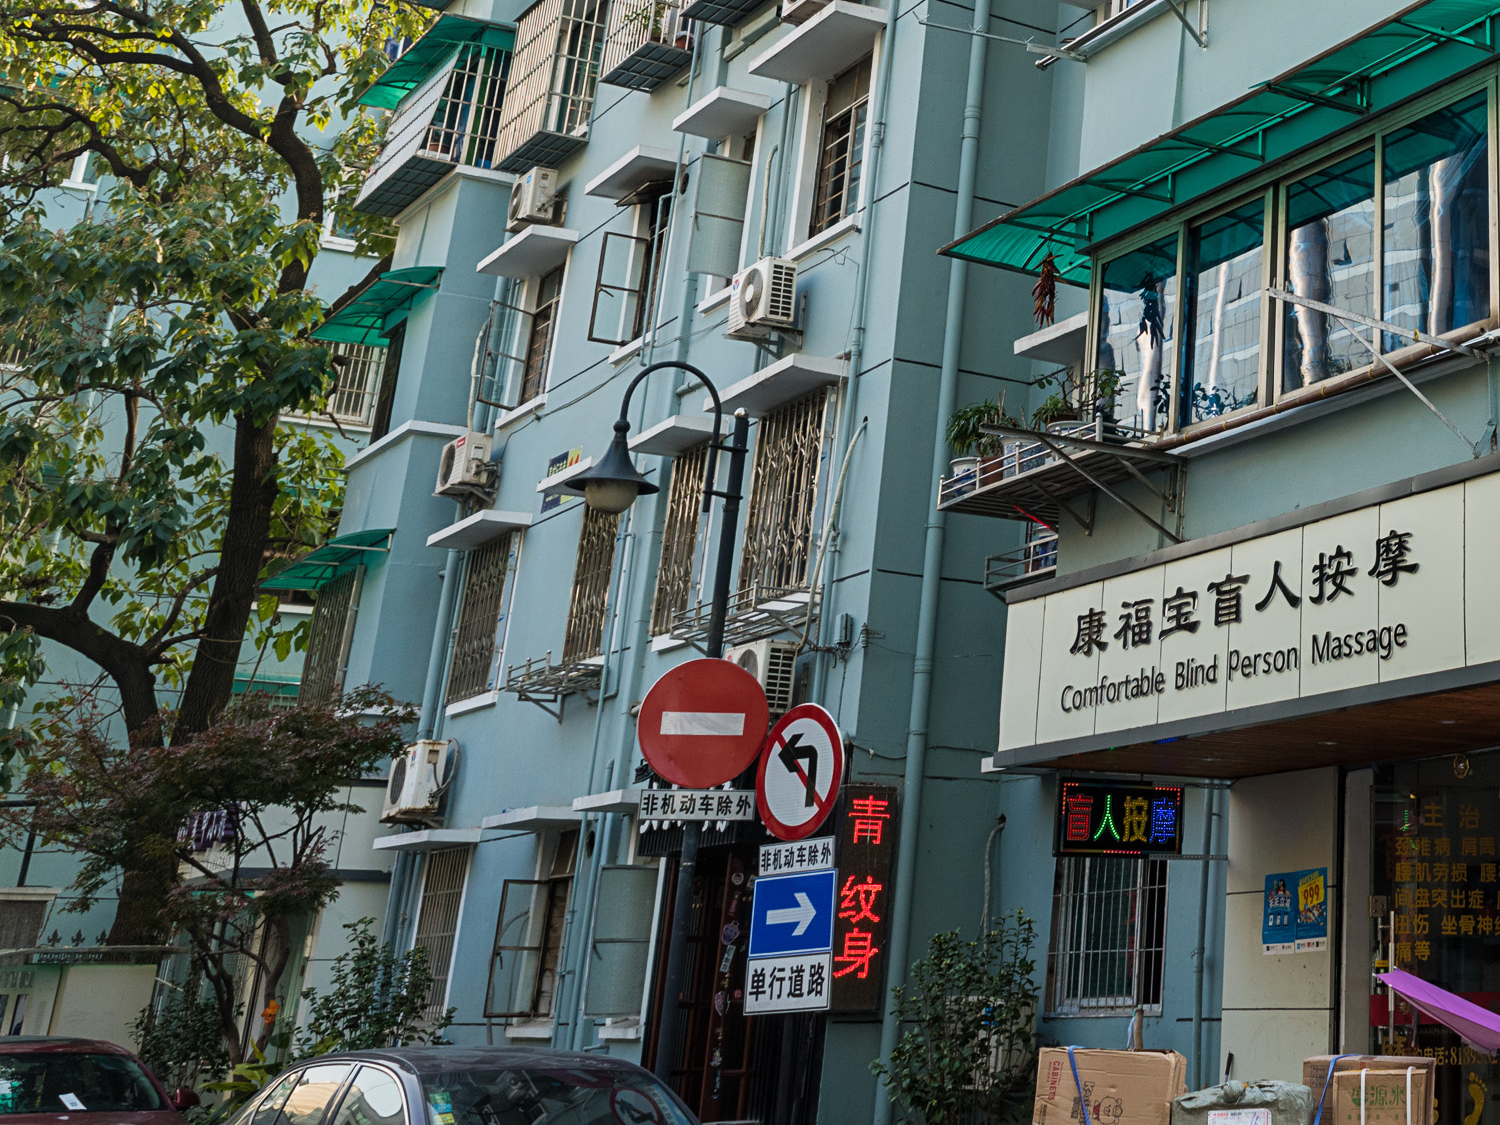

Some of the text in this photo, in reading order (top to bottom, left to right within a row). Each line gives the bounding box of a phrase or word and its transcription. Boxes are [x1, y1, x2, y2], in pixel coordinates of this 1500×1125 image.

[1069, 529, 1420, 657] 康福宝盲人按摩
[1060, 622, 1408, 713] Comfortable Blind Person Massage
[641, 793, 752, 816] 非机动车除外
[1066, 793, 1176, 844] 盲人按摩
[1423, 802, 1480, 829] 主治
[760, 841, 833, 871] 非机动车除外
[1395, 836, 1451, 857] 颈椎病
[1395, 862, 1468, 883] 腰肌劳损
[833, 795, 891, 979] 青纹身
[1395, 888, 1485, 909] 间盘突出症
[1395, 913, 1429, 935] 扭伤
[1395, 940, 1431, 965] 痛等
[748, 962, 826, 1002] 单行道路
[1047, 1060, 1061, 1101] CABINETS
